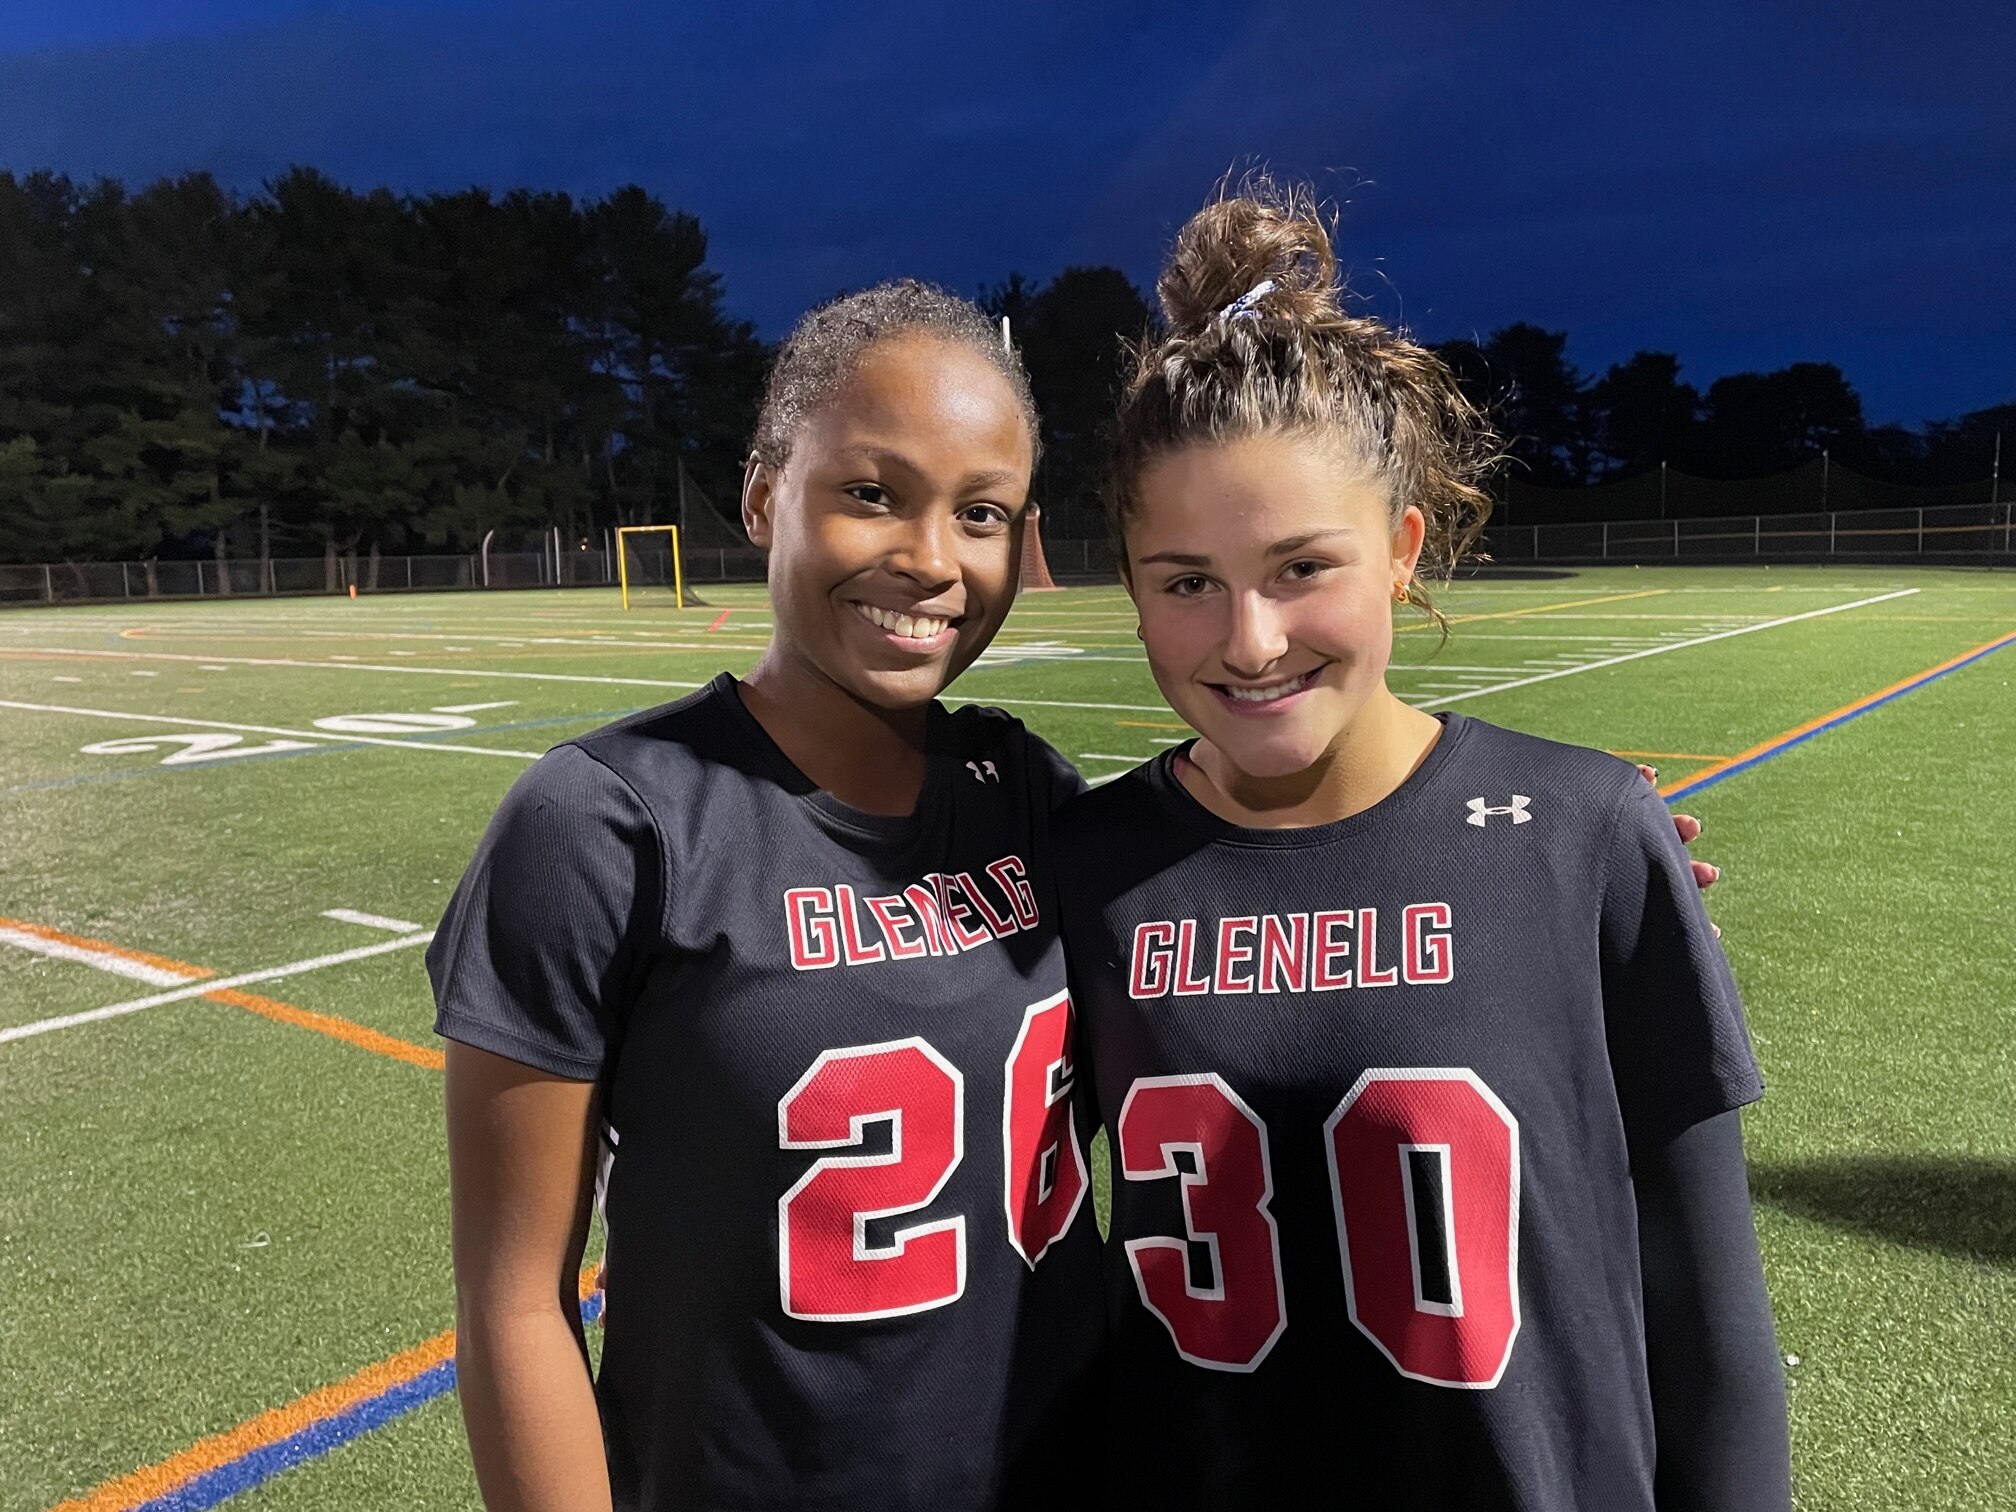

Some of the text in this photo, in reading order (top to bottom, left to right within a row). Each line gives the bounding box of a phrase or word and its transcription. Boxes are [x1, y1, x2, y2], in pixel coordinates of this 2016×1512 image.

[784, 855, 1039, 971] GLENELG
[1129, 902, 1453, 999] GLENELG
[777, 987, 1089, 1321] 26
[1118, 1067, 1521, 1389] 30
